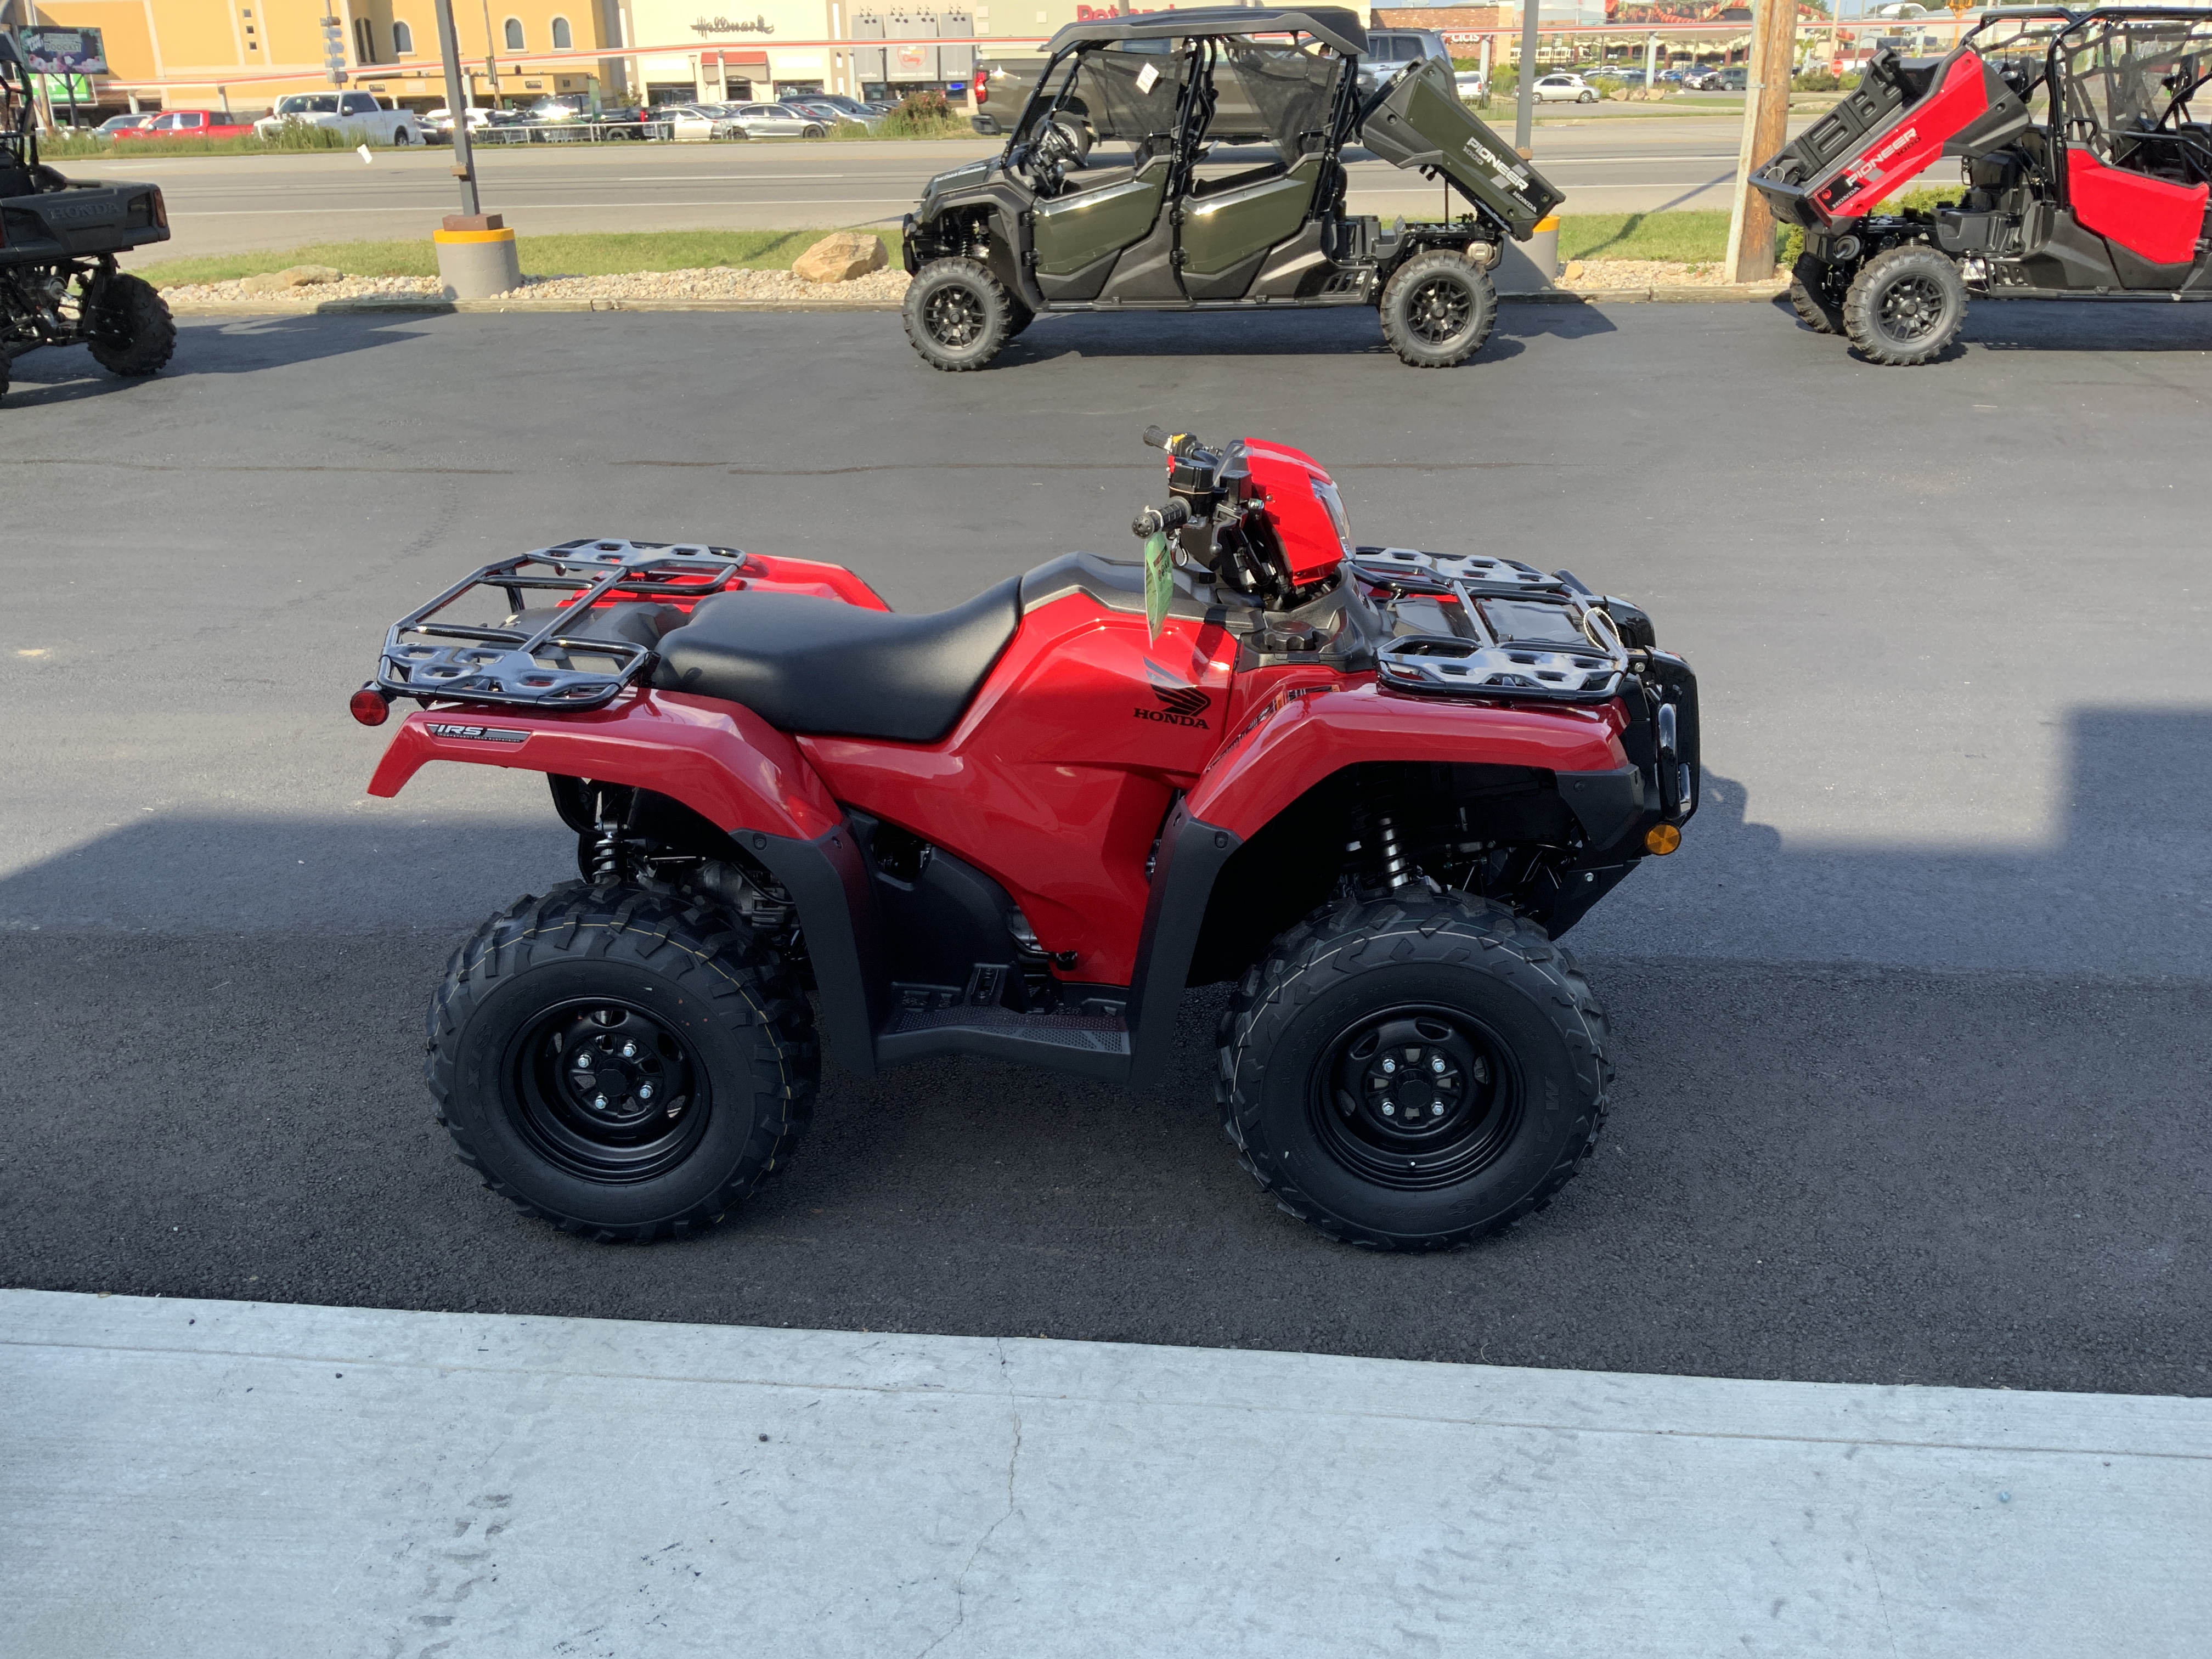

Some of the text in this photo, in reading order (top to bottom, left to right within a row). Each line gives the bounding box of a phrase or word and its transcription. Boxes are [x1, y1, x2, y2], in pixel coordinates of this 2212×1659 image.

[690, 14, 775, 40] Hallmark
[1463, 146, 1484, 166] 1000
[1846, 127, 1917, 187] PIONEER
[1897, 137, 1922, 156] 1000
[1466, 137, 1530, 191] PIONEER
[1512, 191, 1537, 213] HONDA
[1832, 187, 1861, 209] HONDA
[47, 202, 121, 219] HONDA
[1133, 707, 1210, 730] HONDA
[437, 724, 484, 736] IRS
